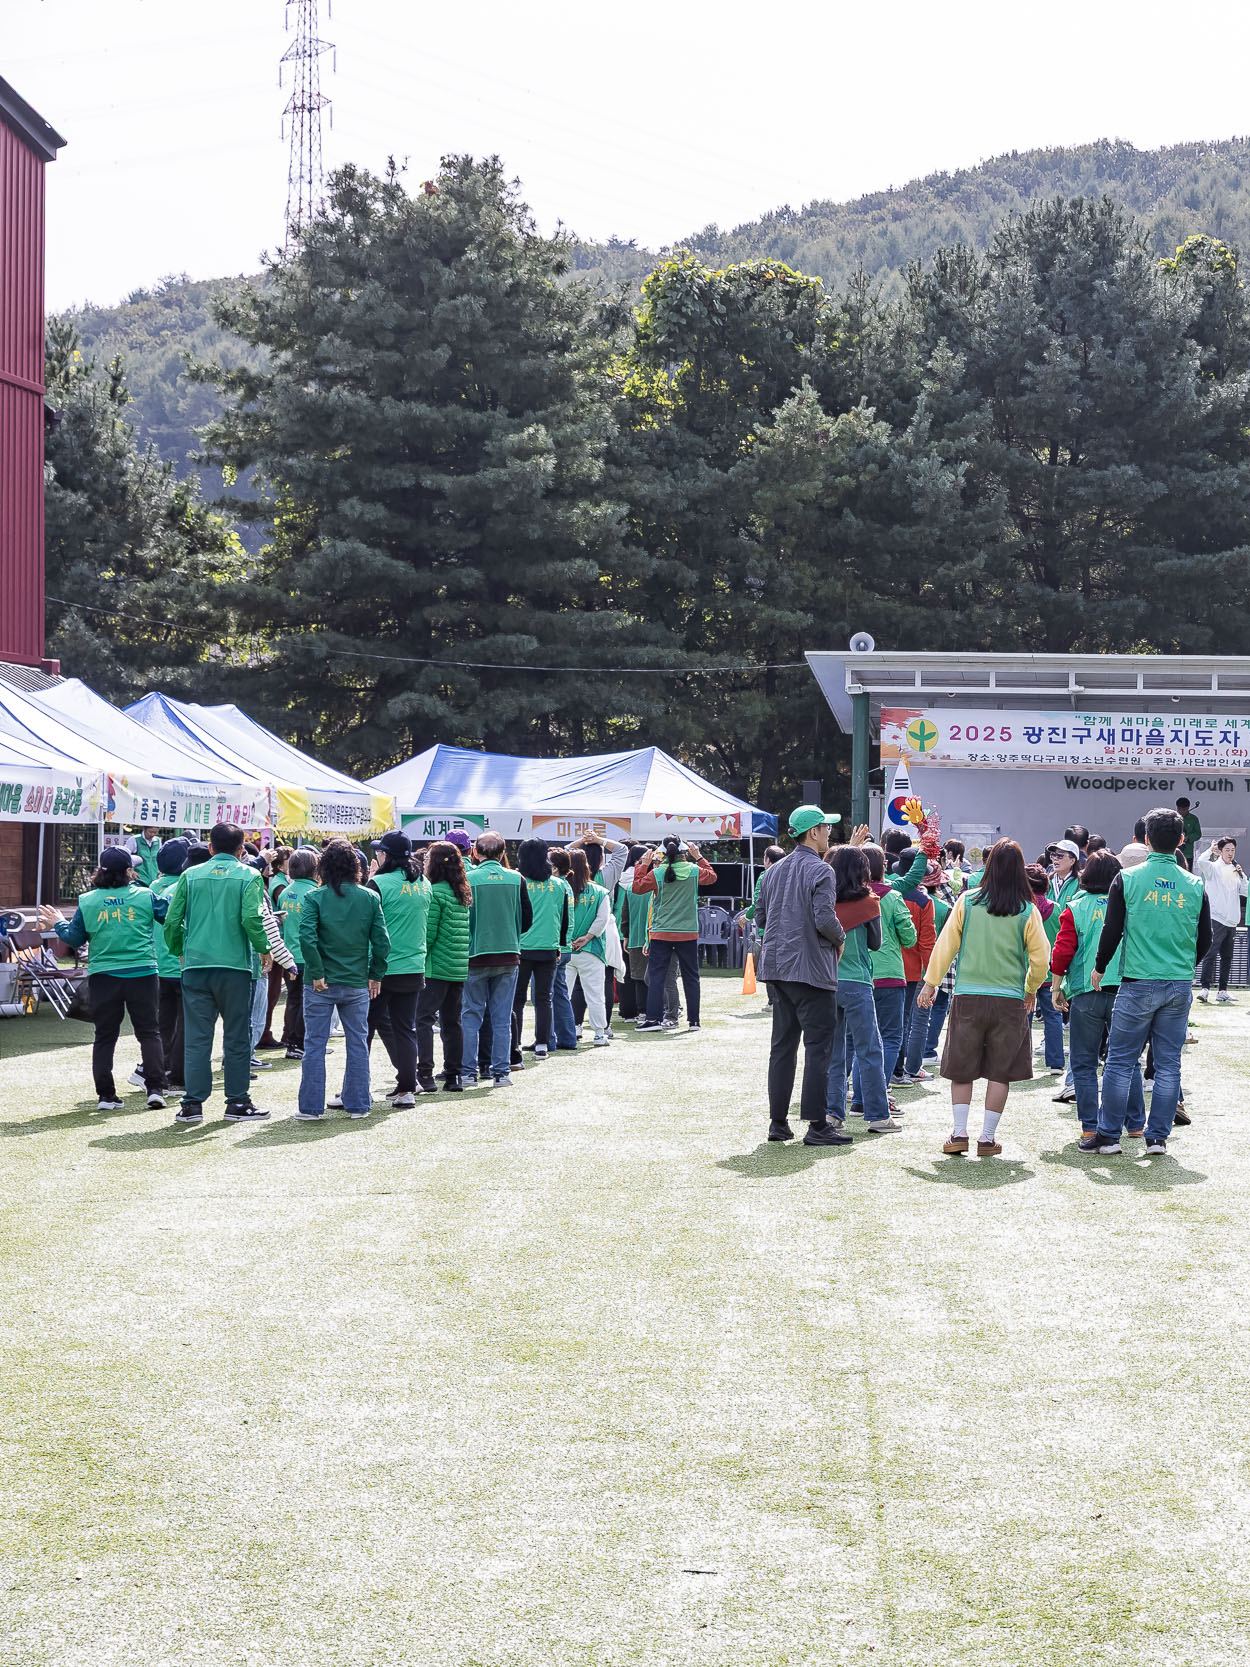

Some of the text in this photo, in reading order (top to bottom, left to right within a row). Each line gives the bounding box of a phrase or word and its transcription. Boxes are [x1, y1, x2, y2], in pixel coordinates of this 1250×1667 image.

[1120, 716, 1218, 729] 새마을,미래로
[949, 725, 1013, 742] 2025
[1022, 726, 1241, 748] 광진구새마을지도자
[967, 753, 1142, 766] 장소:양주딱다구리청소년수련원
[1103, 746, 1249, 757] 일시:2025.10.21.(화)
[1064, 775, 1175, 793] Woodpecker
[1185, 777, 1234, 792] Youth
[53, 787, 83, 816] 중곡2동
[140, 798, 177, 823] 중곡1동
[183, 802, 211, 825] 새마을
[400, 882, 428, 897] 새마을
[1154, 879, 1176, 890] SMU
[103, 897, 125, 907] SMU
[1144, 890, 1187, 909] 새마을
[97, 906, 137, 923] 새마을
